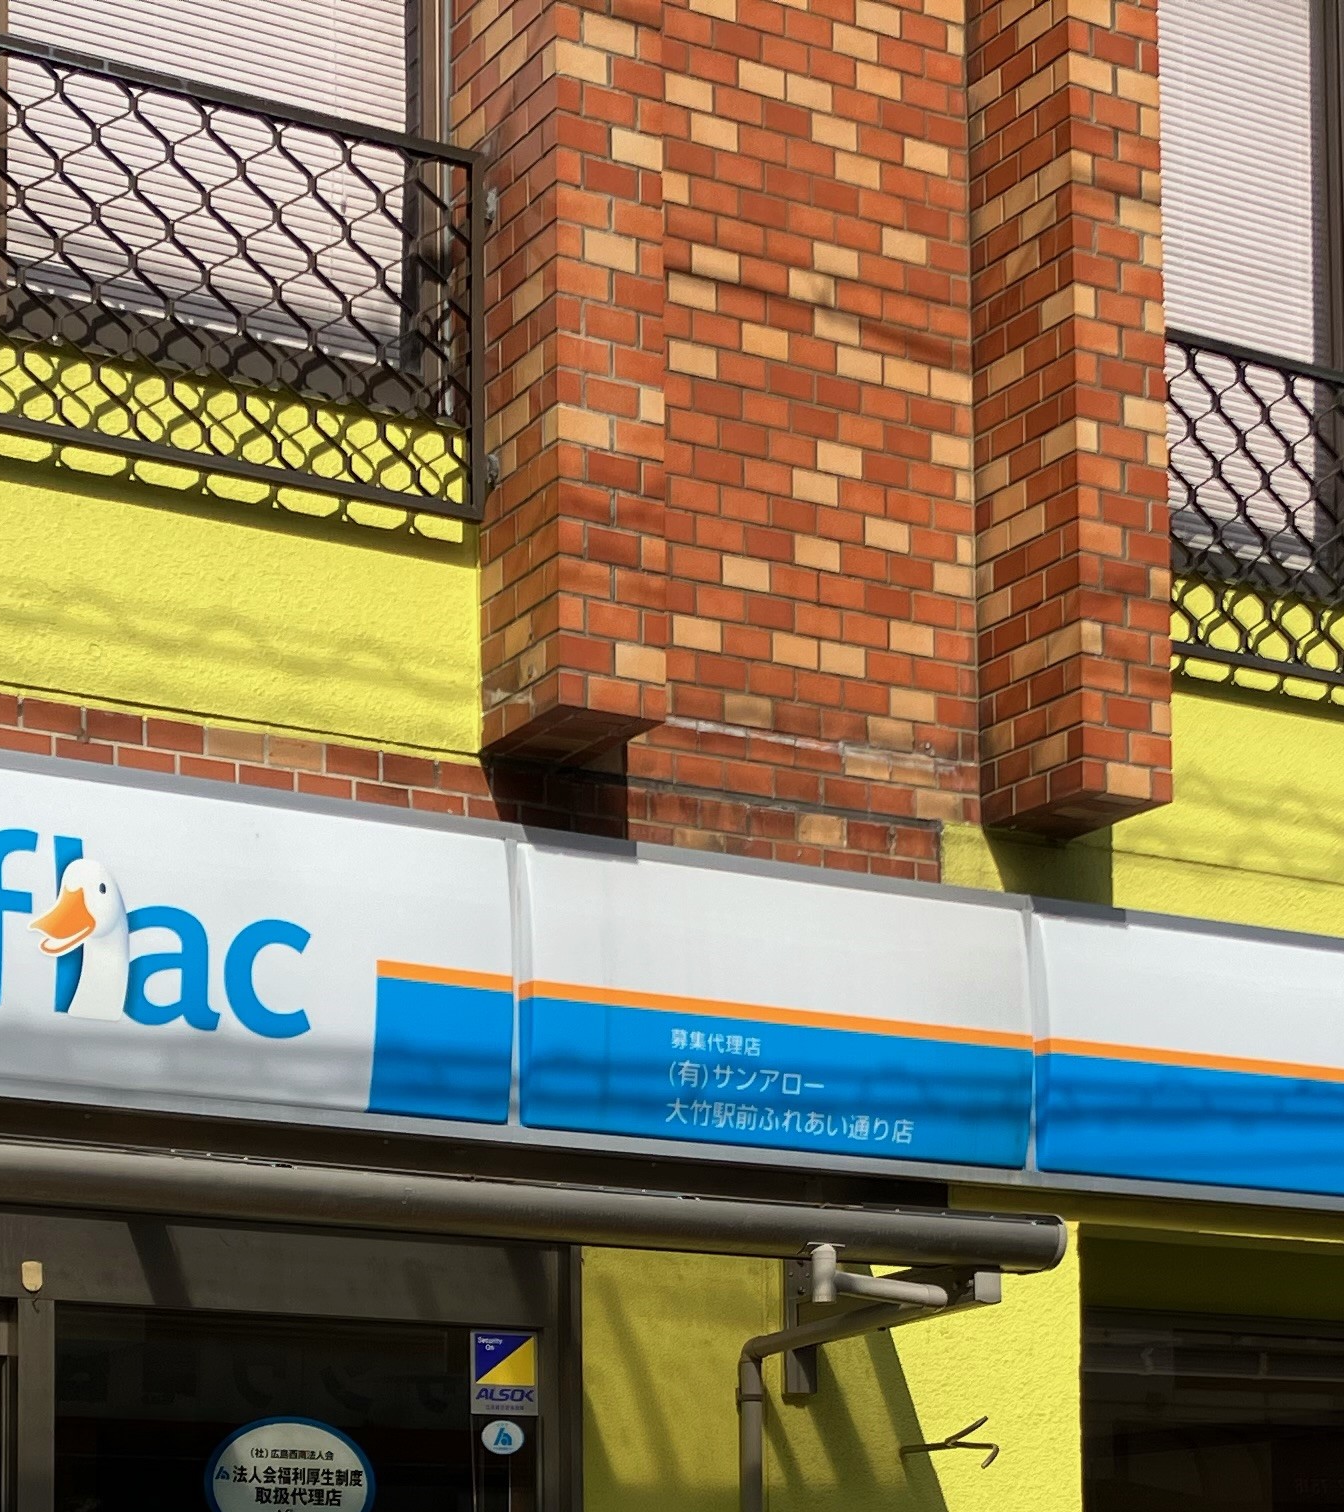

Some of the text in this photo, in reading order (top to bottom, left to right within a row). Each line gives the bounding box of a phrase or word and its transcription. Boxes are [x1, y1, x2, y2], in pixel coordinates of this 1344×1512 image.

[671, 1029, 761, 1057] 募集代理店
[665, 1098, 915, 1144] 大竹駅前ふれあい通り店
[476, 1387, 534, 1403] ALSOK
[232, 1465, 363, 1488] 法人会福利厚生制度
[255, 1487, 343, 1507] 取扱代理店
